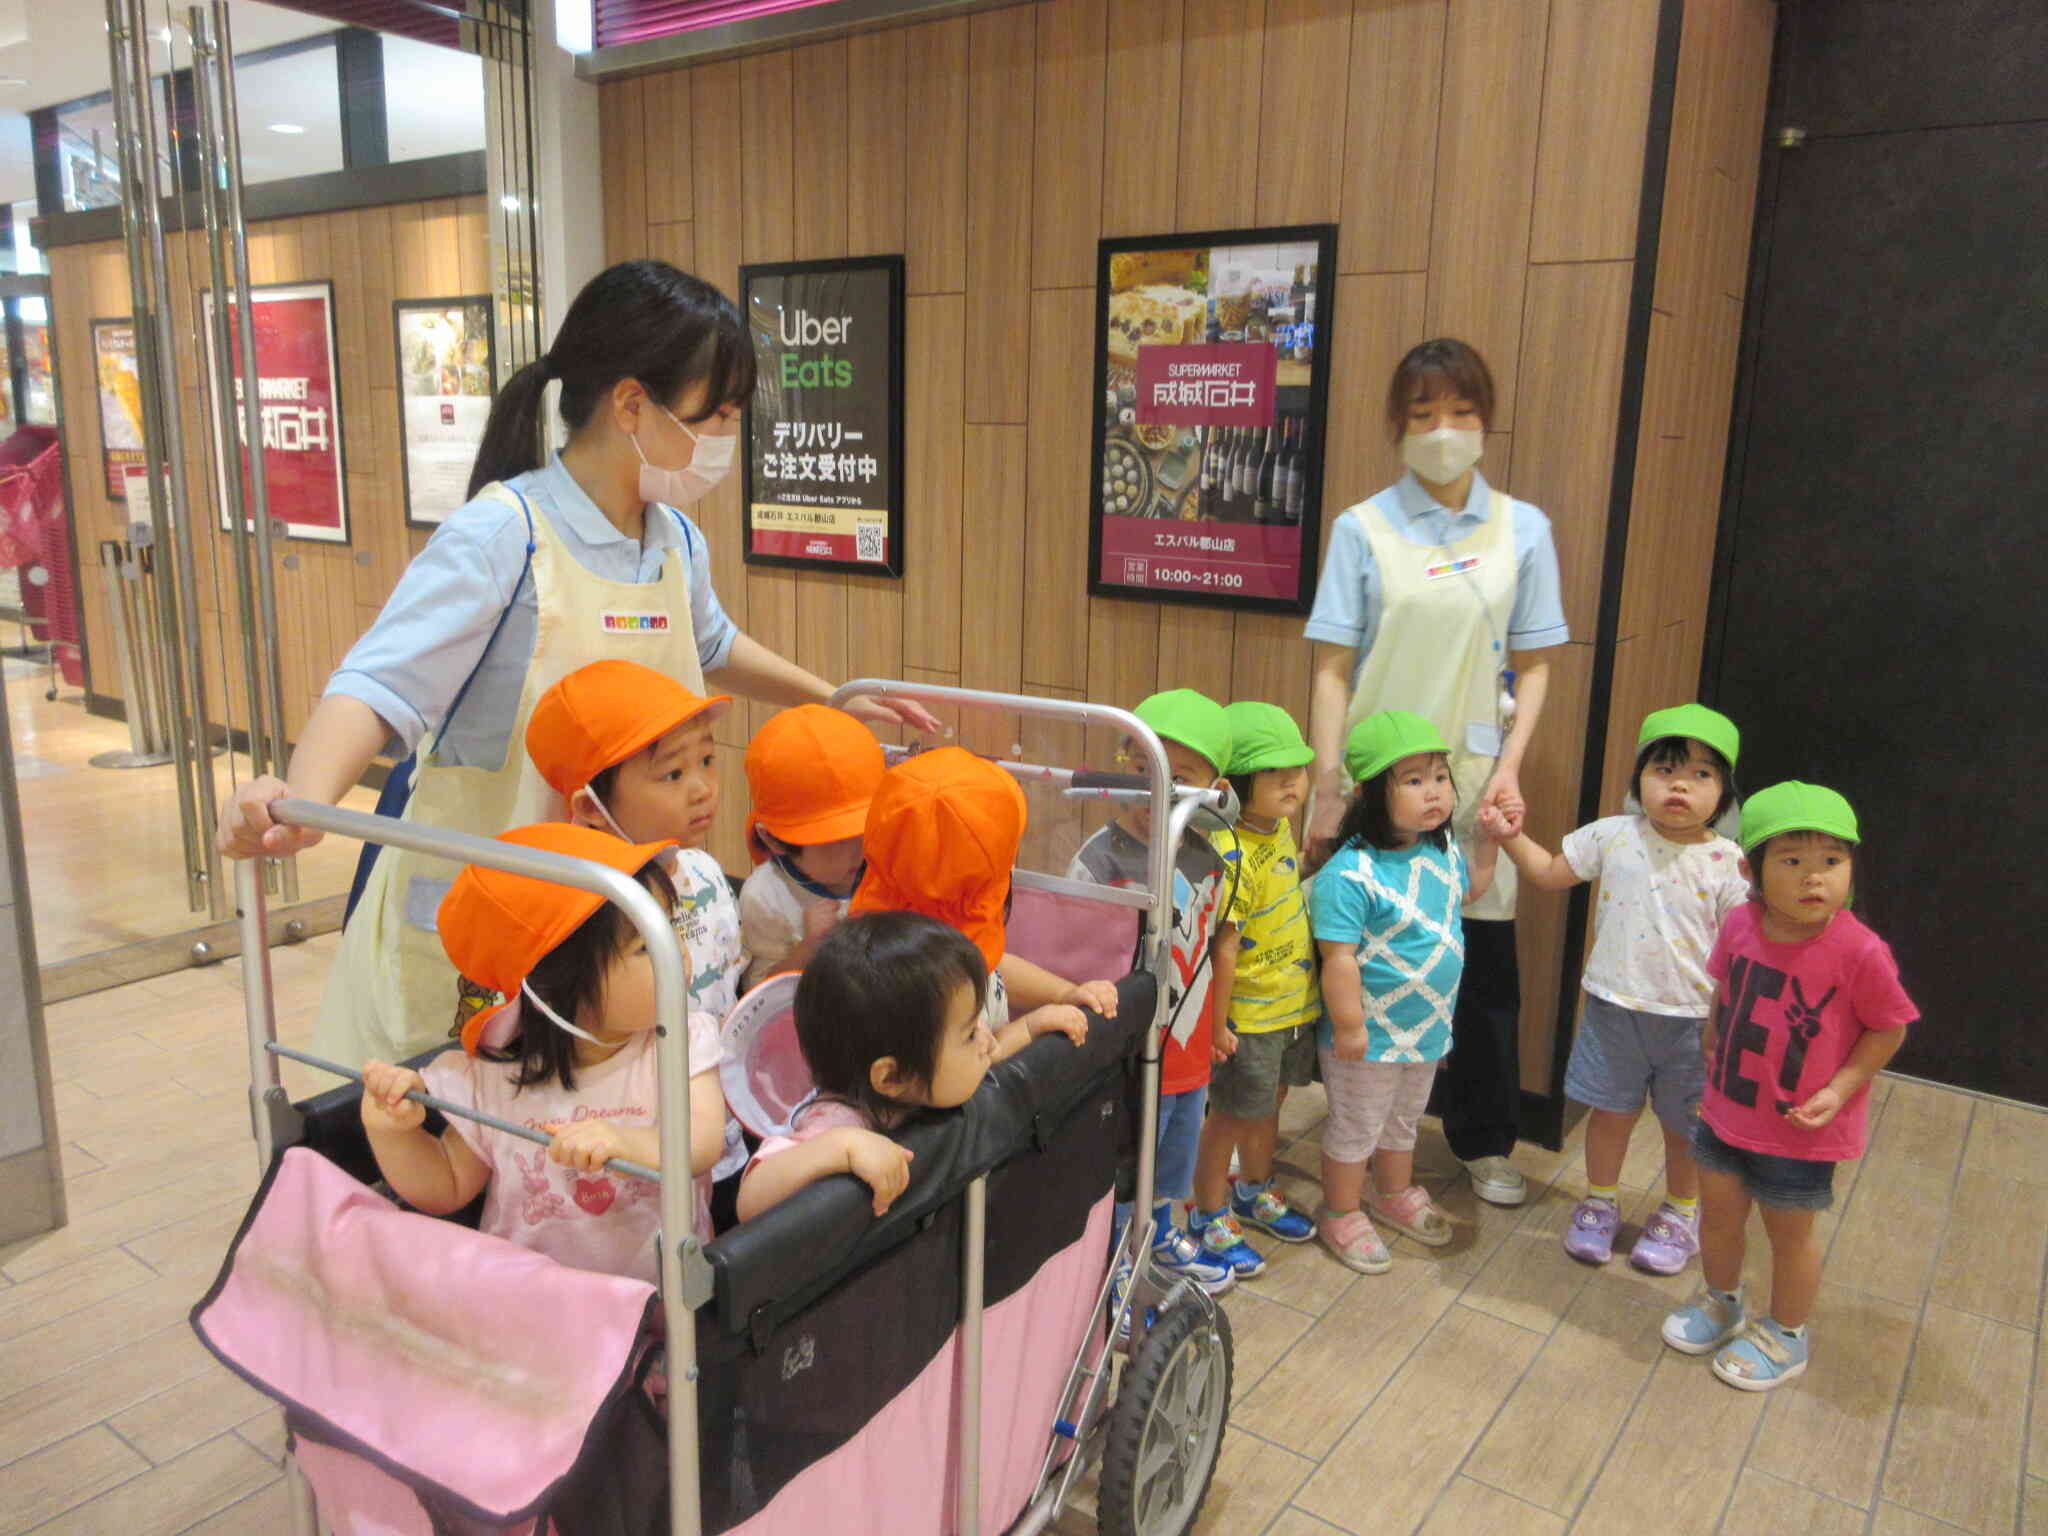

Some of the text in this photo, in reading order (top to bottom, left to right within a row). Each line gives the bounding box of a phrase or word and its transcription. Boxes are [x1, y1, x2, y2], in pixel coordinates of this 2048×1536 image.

[780, 309, 852, 346] Uber
[782, 353, 853, 388] Eats
[1168, 363, 1242, 377] SUPERMARKET
[1154, 380, 1256, 407] 成城石井
[773, 422, 863, 449] デリバリー
[763, 452, 877, 483] ご注文受付中
[1154, 534, 1236, 552] エスパル郡山店
